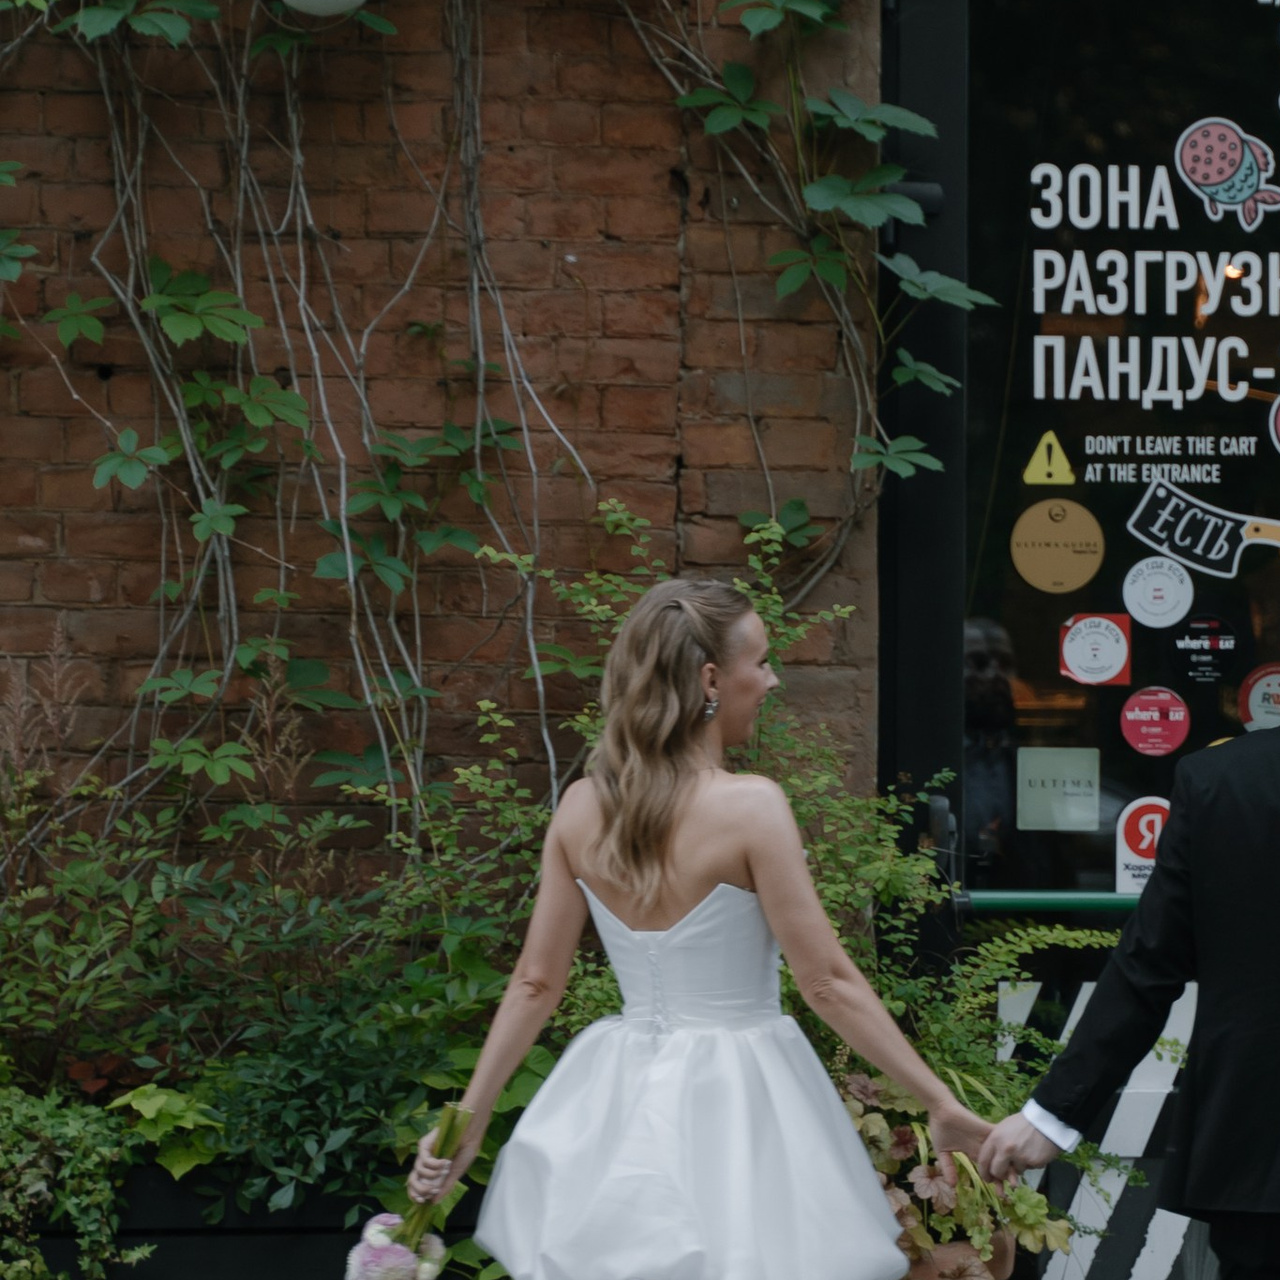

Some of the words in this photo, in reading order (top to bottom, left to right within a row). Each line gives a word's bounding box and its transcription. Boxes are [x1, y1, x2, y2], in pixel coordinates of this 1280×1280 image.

[1030, 163, 1180, 230] ЗОНА
[1084, 435, 1132, 455] DON'T
[1136, 435, 1182, 455] LEAVE
[1186, 436, 1215, 455] THE
[1219, 436, 1258, 456] CART
[1084, 463, 1104, 483] AT
[1107, 463, 1137, 483] THE
[1142, 463, 1222, 484] ENTRANCE
[1148, 495, 1236, 561] ЕСТЬ
[1028, 779, 1094, 789] ULTIMA
[1138, 813, 1162, 850] Я
[1123, 863, 1156, 872] Хоро
